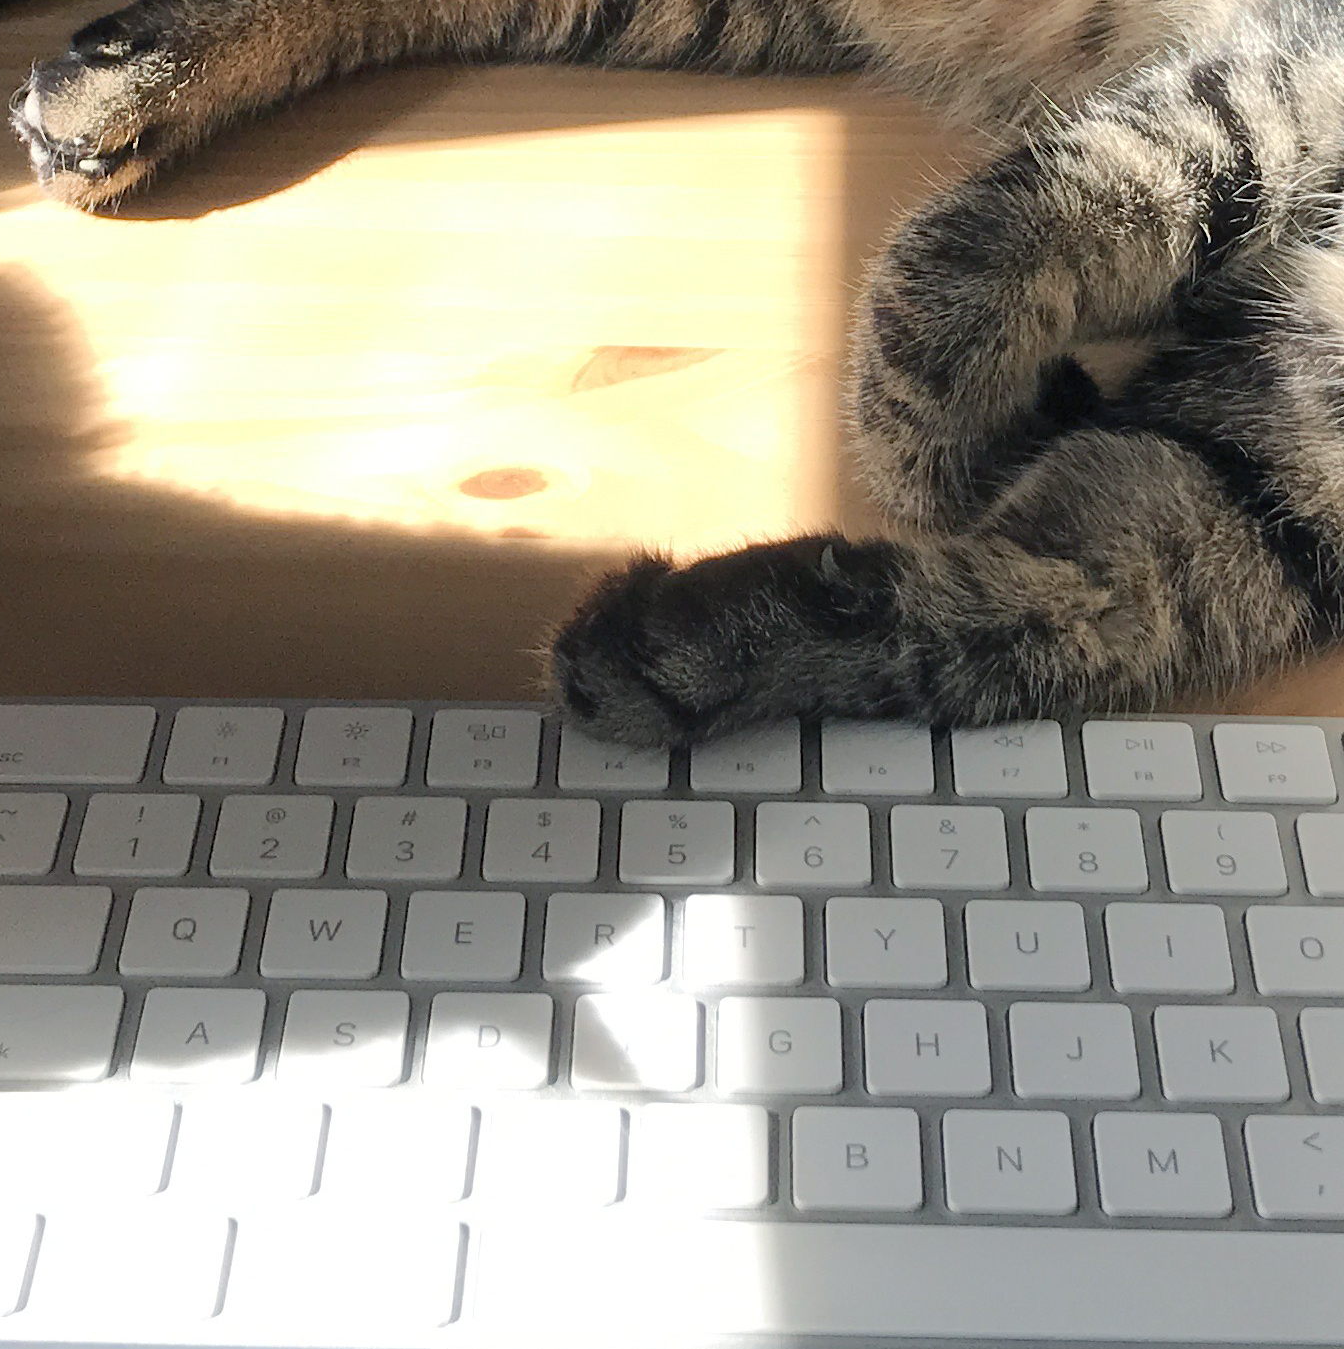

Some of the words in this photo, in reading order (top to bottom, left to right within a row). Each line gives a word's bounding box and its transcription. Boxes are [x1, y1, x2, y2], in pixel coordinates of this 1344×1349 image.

[868, 765, 887, 775] F6
[1001, 767, 1020, 778] F7
[1134, 771, 1154, 781] F8
[1267, 774, 1287, 784] F9
[259, 837, 280, 860] 2
[395, 840, 415, 863] 3
[531, 841, 551, 863] 4
[667, 843, 687, 865] 5
[803, 846, 824, 868] 6
[940, 848, 959, 870] 7
[1078, 851, 1099, 873] 8
[1215, 854, 1238, 876] 9
[172, 917, 197, 943] Q
[309, 919, 343, 942] W
[454, 921, 473, 945] E
[595, 923, 616, 946] R
[734, 925, 755, 948] T
[874, 928, 896, 951] Y
[1015, 931, 1039, 954] U
[1299, 936, 1325, 960] O
[185, 1021, 210, 1045] A
[334, 1022, 357, 1046] S
[478, 1024, 501, 1048] D
[768, 1029, 793, 1055] G
[915, 1033, 940, 1057] H
[1066, 1036, 1083, 1061] J
[1209, 1039, 1233, 1064] K
[845, 1143, 869, 1170] B
[996, 1146, 1023, 1172] N
[1147, 1148, 1179, 1175] M
